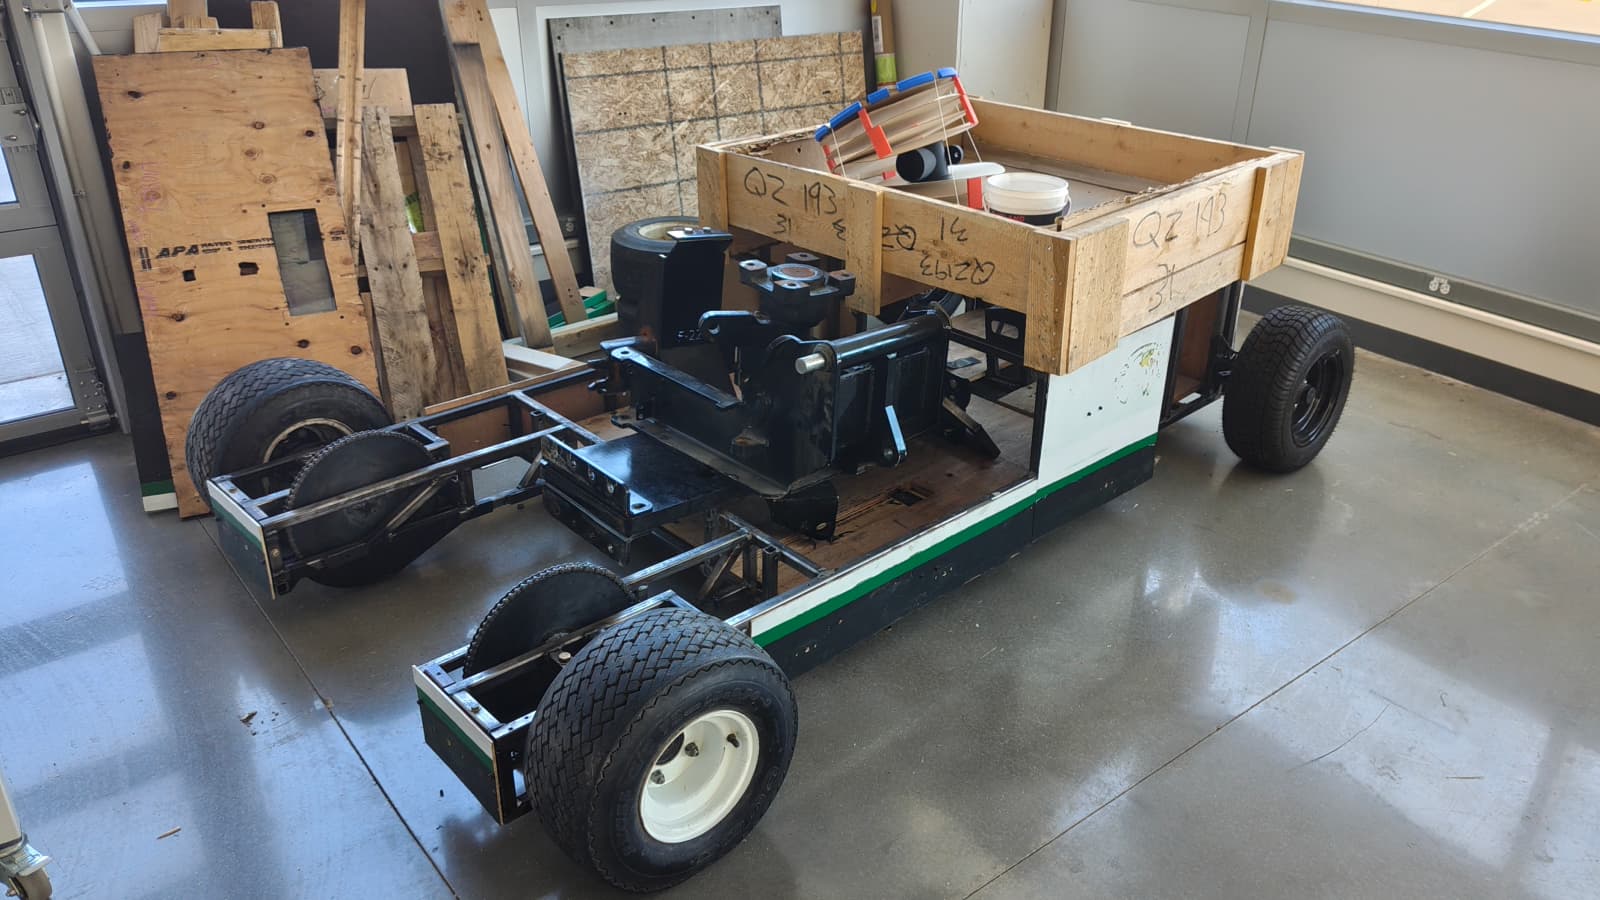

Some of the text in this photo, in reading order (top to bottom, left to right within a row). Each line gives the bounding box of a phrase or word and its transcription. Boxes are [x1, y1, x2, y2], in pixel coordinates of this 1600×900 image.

[803, 182, 838, 216] 193
[773, 213, 792, 236] 31
[1133, 192, 1227, 248] QZ 193
[155, 244, 200, 259] APA
